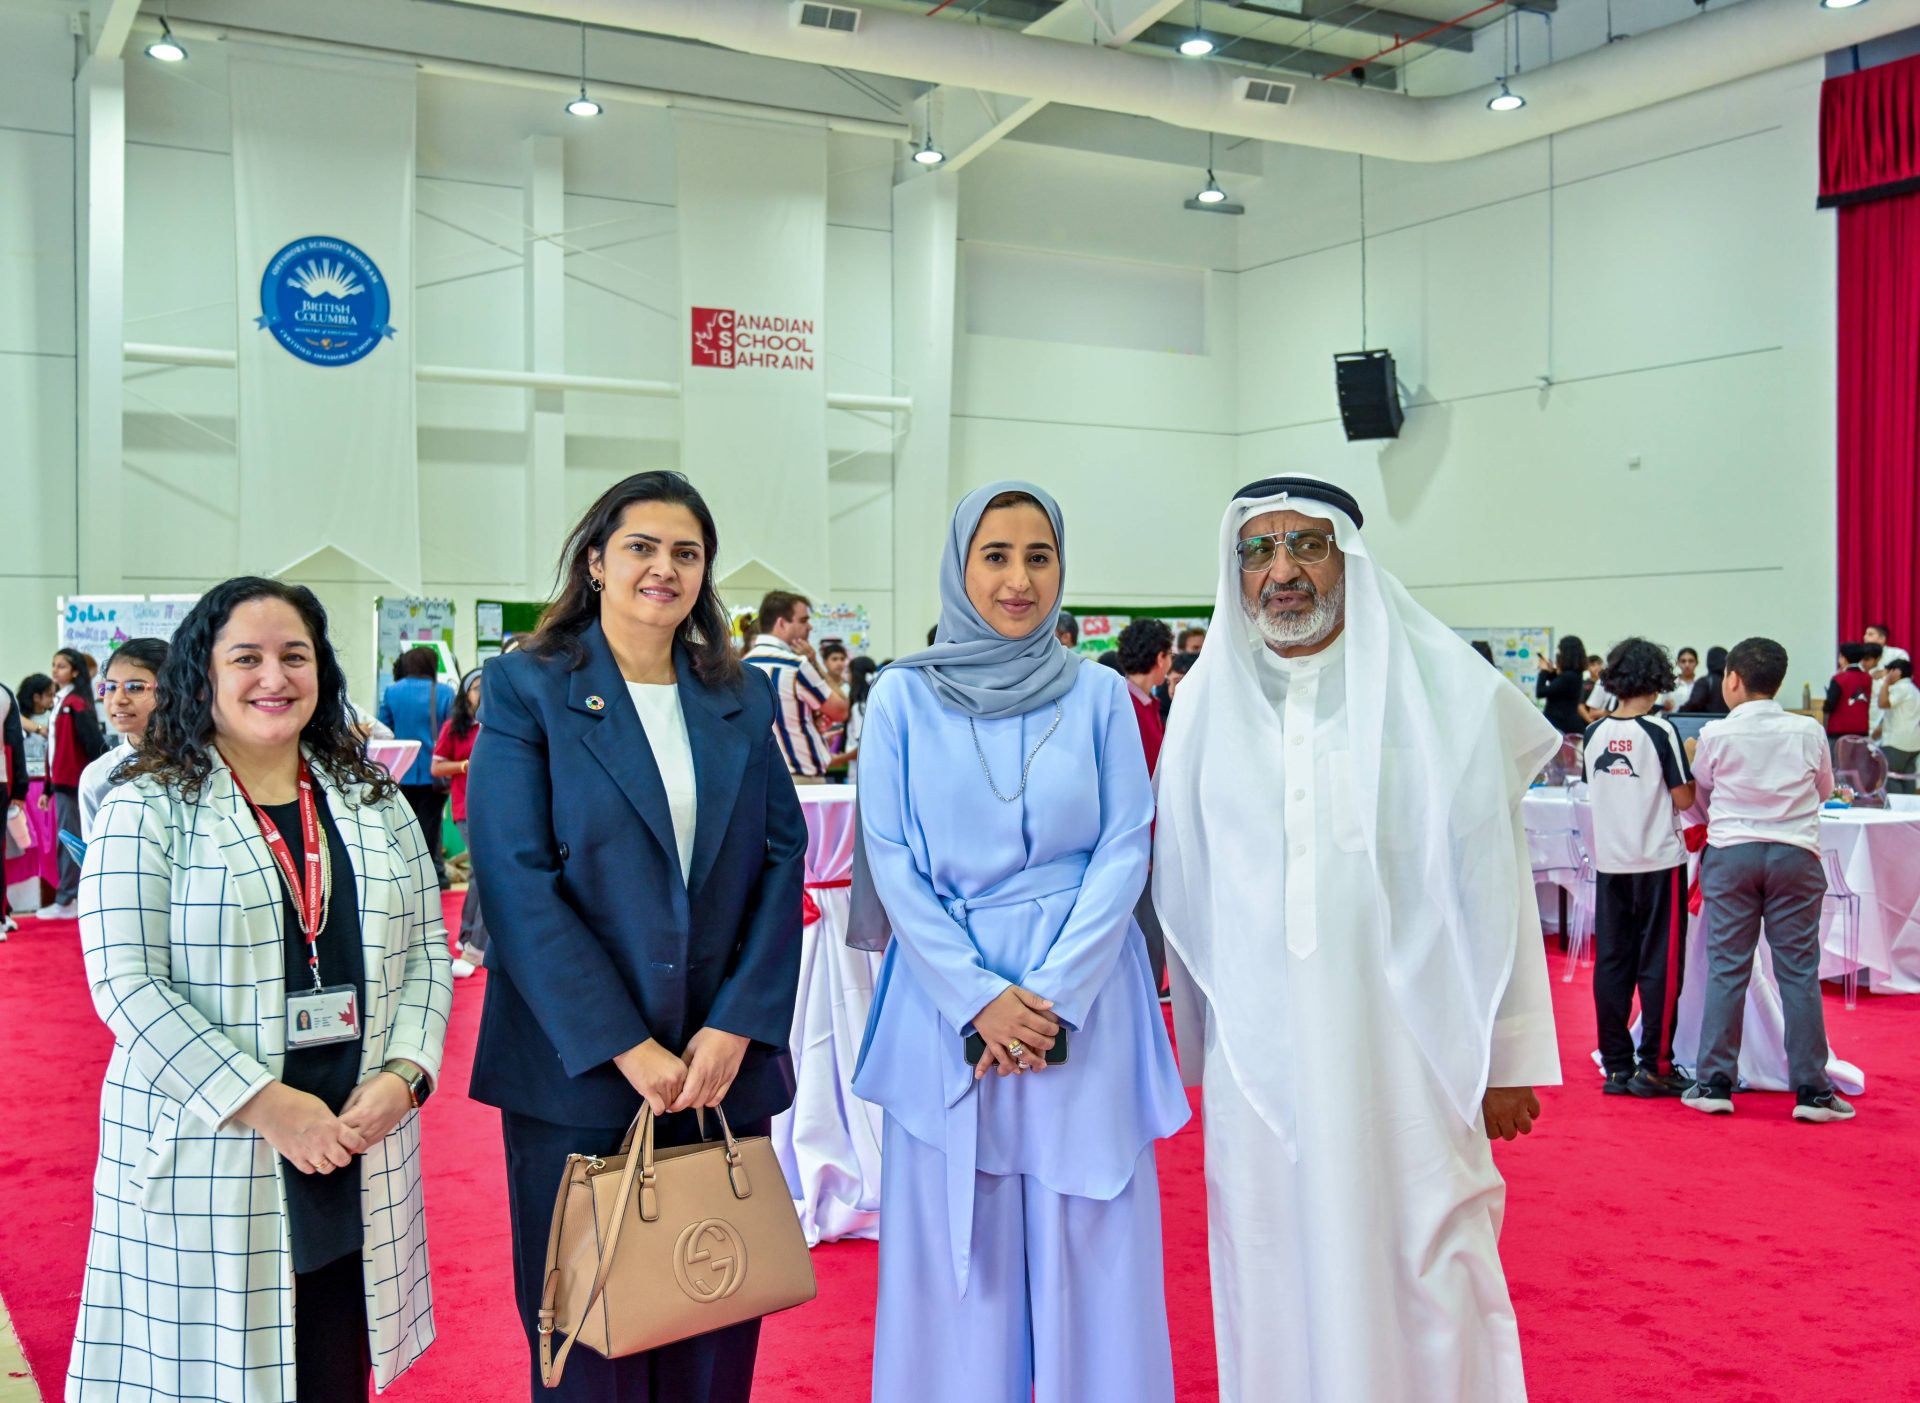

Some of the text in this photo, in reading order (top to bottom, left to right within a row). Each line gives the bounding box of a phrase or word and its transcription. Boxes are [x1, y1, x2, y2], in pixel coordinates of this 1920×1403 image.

[308, 241, 343, 252] SCHOOL
[345, 248, 379, 284] PROGRAM
[294, 310, 358, 326] COLUMBIA
[302, 300, 351, 314] BRITISH
[718, 312, 814, 335] CANADIAN
[719, 331, 813, 353] SCHOOL
[720, 349, 814, 371] BAHRAIN
[1609, 739, 1633, 752] CSB
